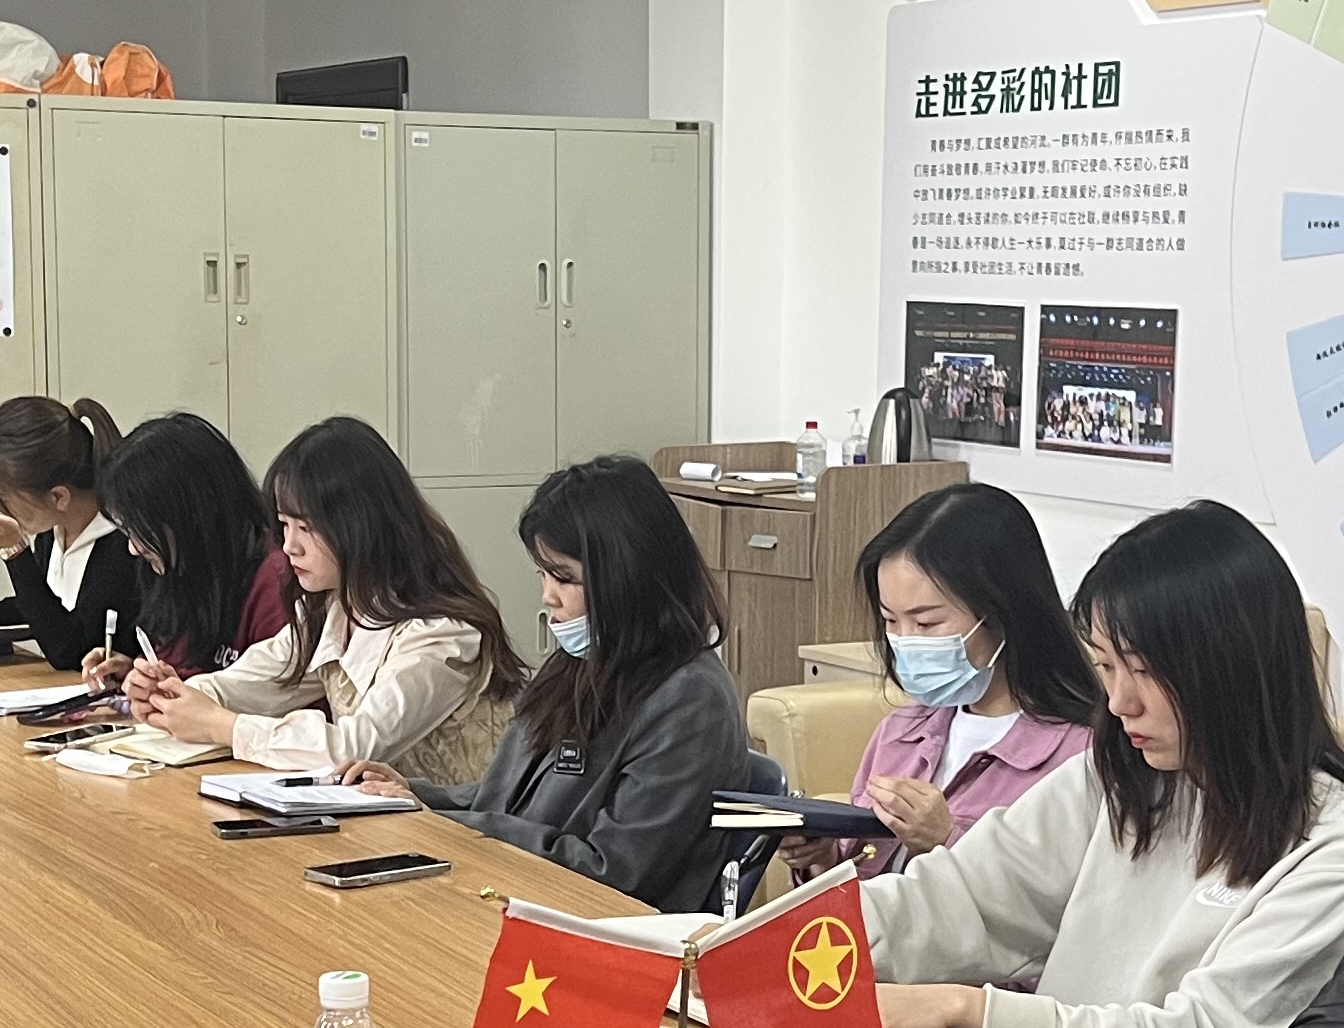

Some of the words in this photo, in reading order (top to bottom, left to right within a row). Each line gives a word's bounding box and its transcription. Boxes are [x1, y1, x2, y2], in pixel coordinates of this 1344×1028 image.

[915, 61, 1121, 118] 走进多彩的社团
